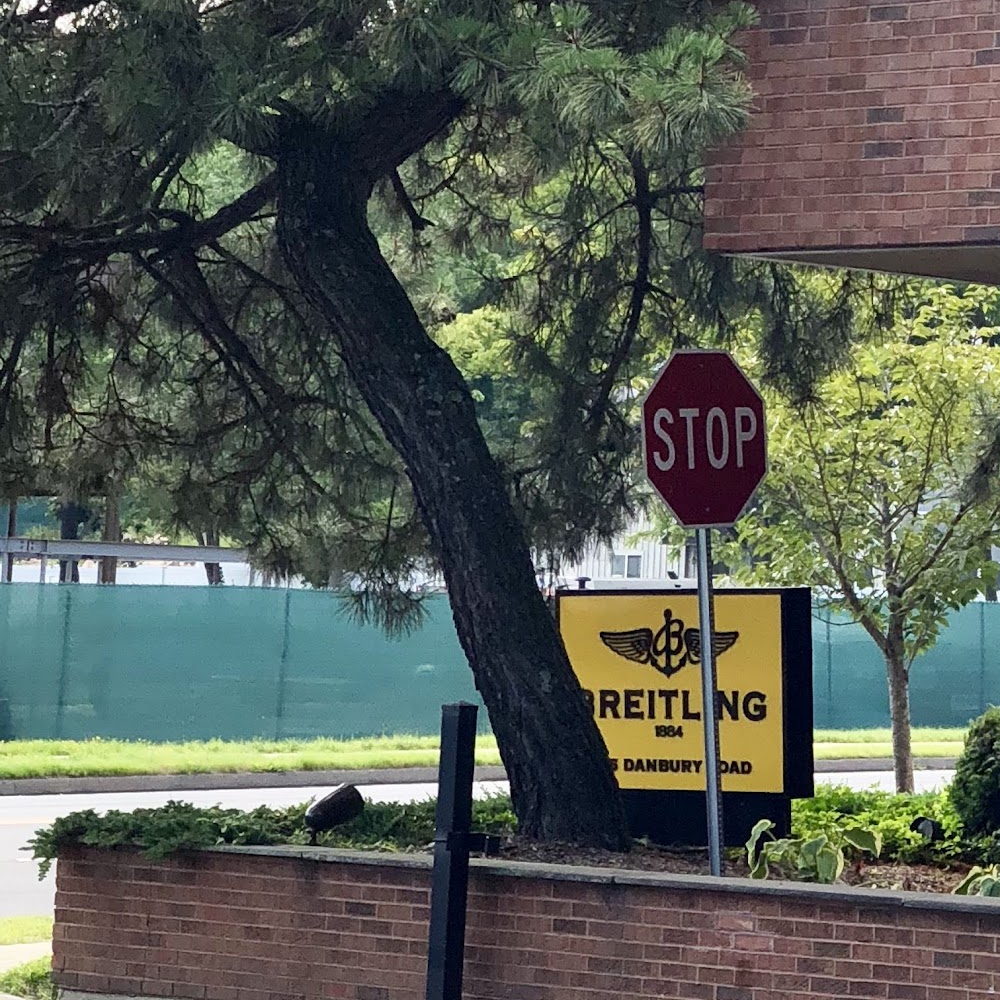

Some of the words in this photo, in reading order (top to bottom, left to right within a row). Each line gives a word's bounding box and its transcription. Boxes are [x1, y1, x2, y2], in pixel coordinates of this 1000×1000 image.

[653, 406, 757, 472] STOP
[581, 688, 767, 721] REITLNG
[655, 725, 683, 737] 1884
[623, 758, 702, 773] DANBURY
[720, 760, 752, 774] OAD
